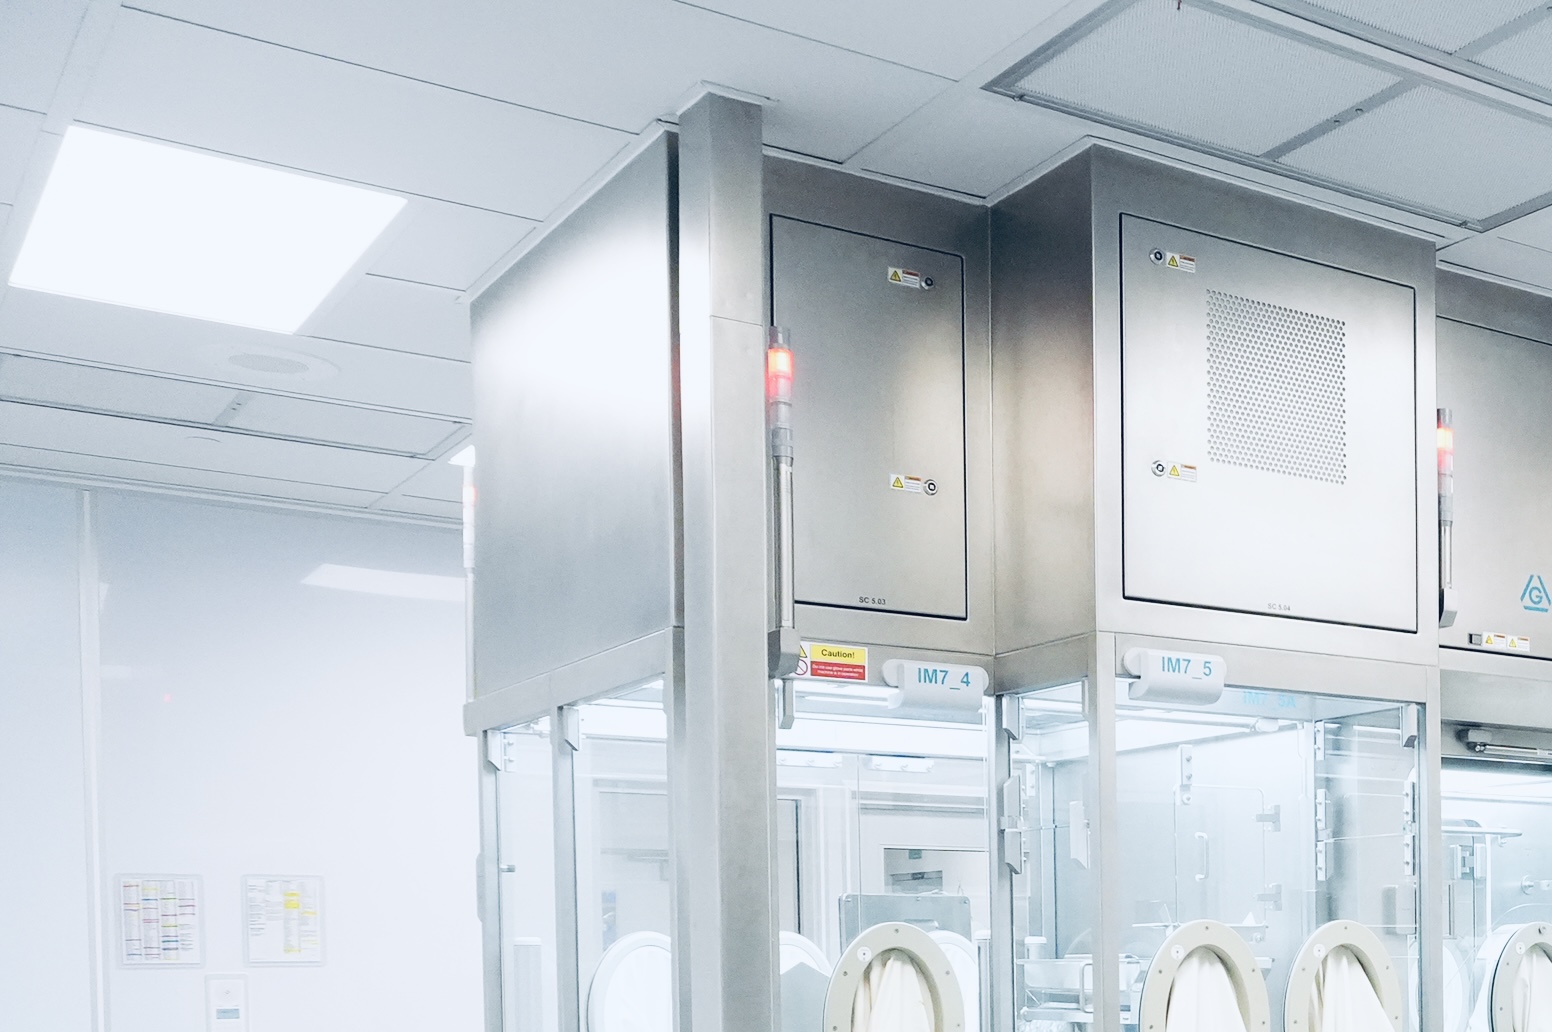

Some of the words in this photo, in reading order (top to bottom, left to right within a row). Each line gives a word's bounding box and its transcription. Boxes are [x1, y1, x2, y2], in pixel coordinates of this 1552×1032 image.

[858, 596, 870, 604] SC
[871, 597, 887, 606] 5.03
[1267, 602, 1277, 610] SC
[821, 648, 855, 659] Caution!
[1161, 656, 1212, 680] IM7_5
[917, 667, 971, 690] IM7_4
